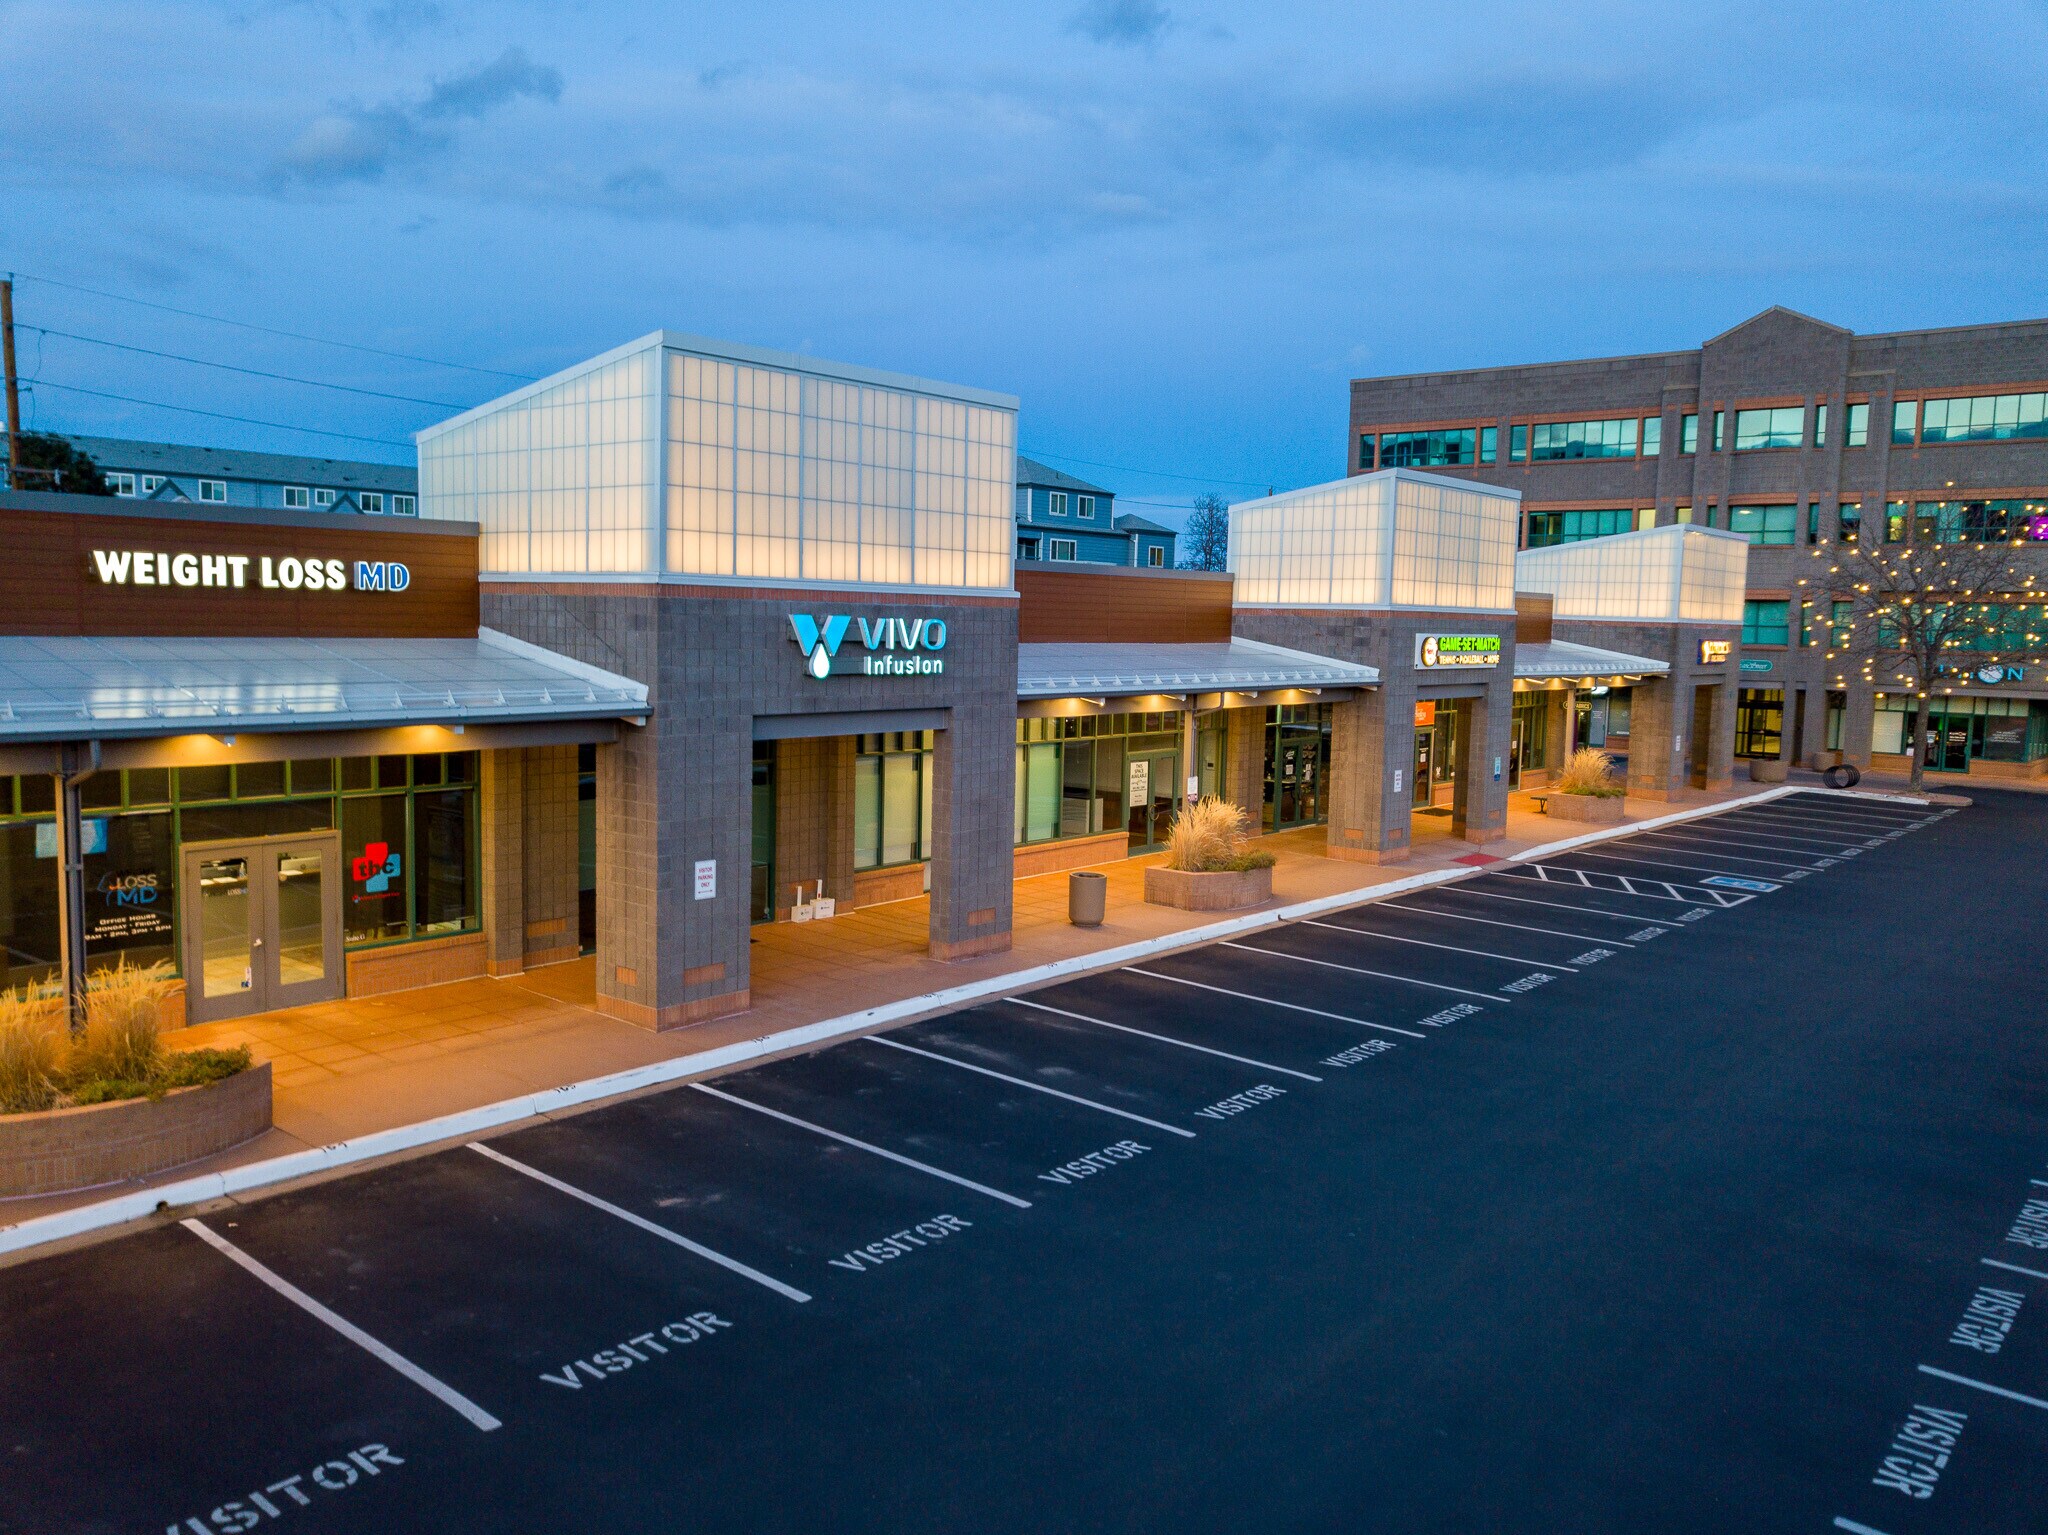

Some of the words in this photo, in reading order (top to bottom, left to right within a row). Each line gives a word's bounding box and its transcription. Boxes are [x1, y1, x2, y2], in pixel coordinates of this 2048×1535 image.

[93, 550, 248, 586] WEIGHT
[260, 556, 346, 588] LOSS
[354, 560, 410, 592] MD
[857, 617, 947, 650] VIVO
[864, 655, 943, 675] Infusion
[116, 873, 158, 890] LOSS
[358, 860, 395, 877] thc
[116, 886, 158, 907] MD
[94, 924, 127, 933] MONDAY
[99, 917, 127, 925] OFFICE
[1566, 948, 1616, 966] VISITOR
[1500, 972, 1557, 994] VISITOR
[1417, 1003, 1484, 1028] VISITOR
[1319, 1038, 1397, 1068] VISITOR
[1194, 1083, 1287, 1121] VISITOR
[1037, 1139, 1152, 1185] VISITOR
[828, 1213, 973, 1273] VISITOR
[1949, 1286, 2026, 1354] VISITOR
[538, 1310, 734, 1390] VISITOR
[1872, 1403, 1969, 1500] VISITOR
[165, 1443, 405, 1535] ISITOR
